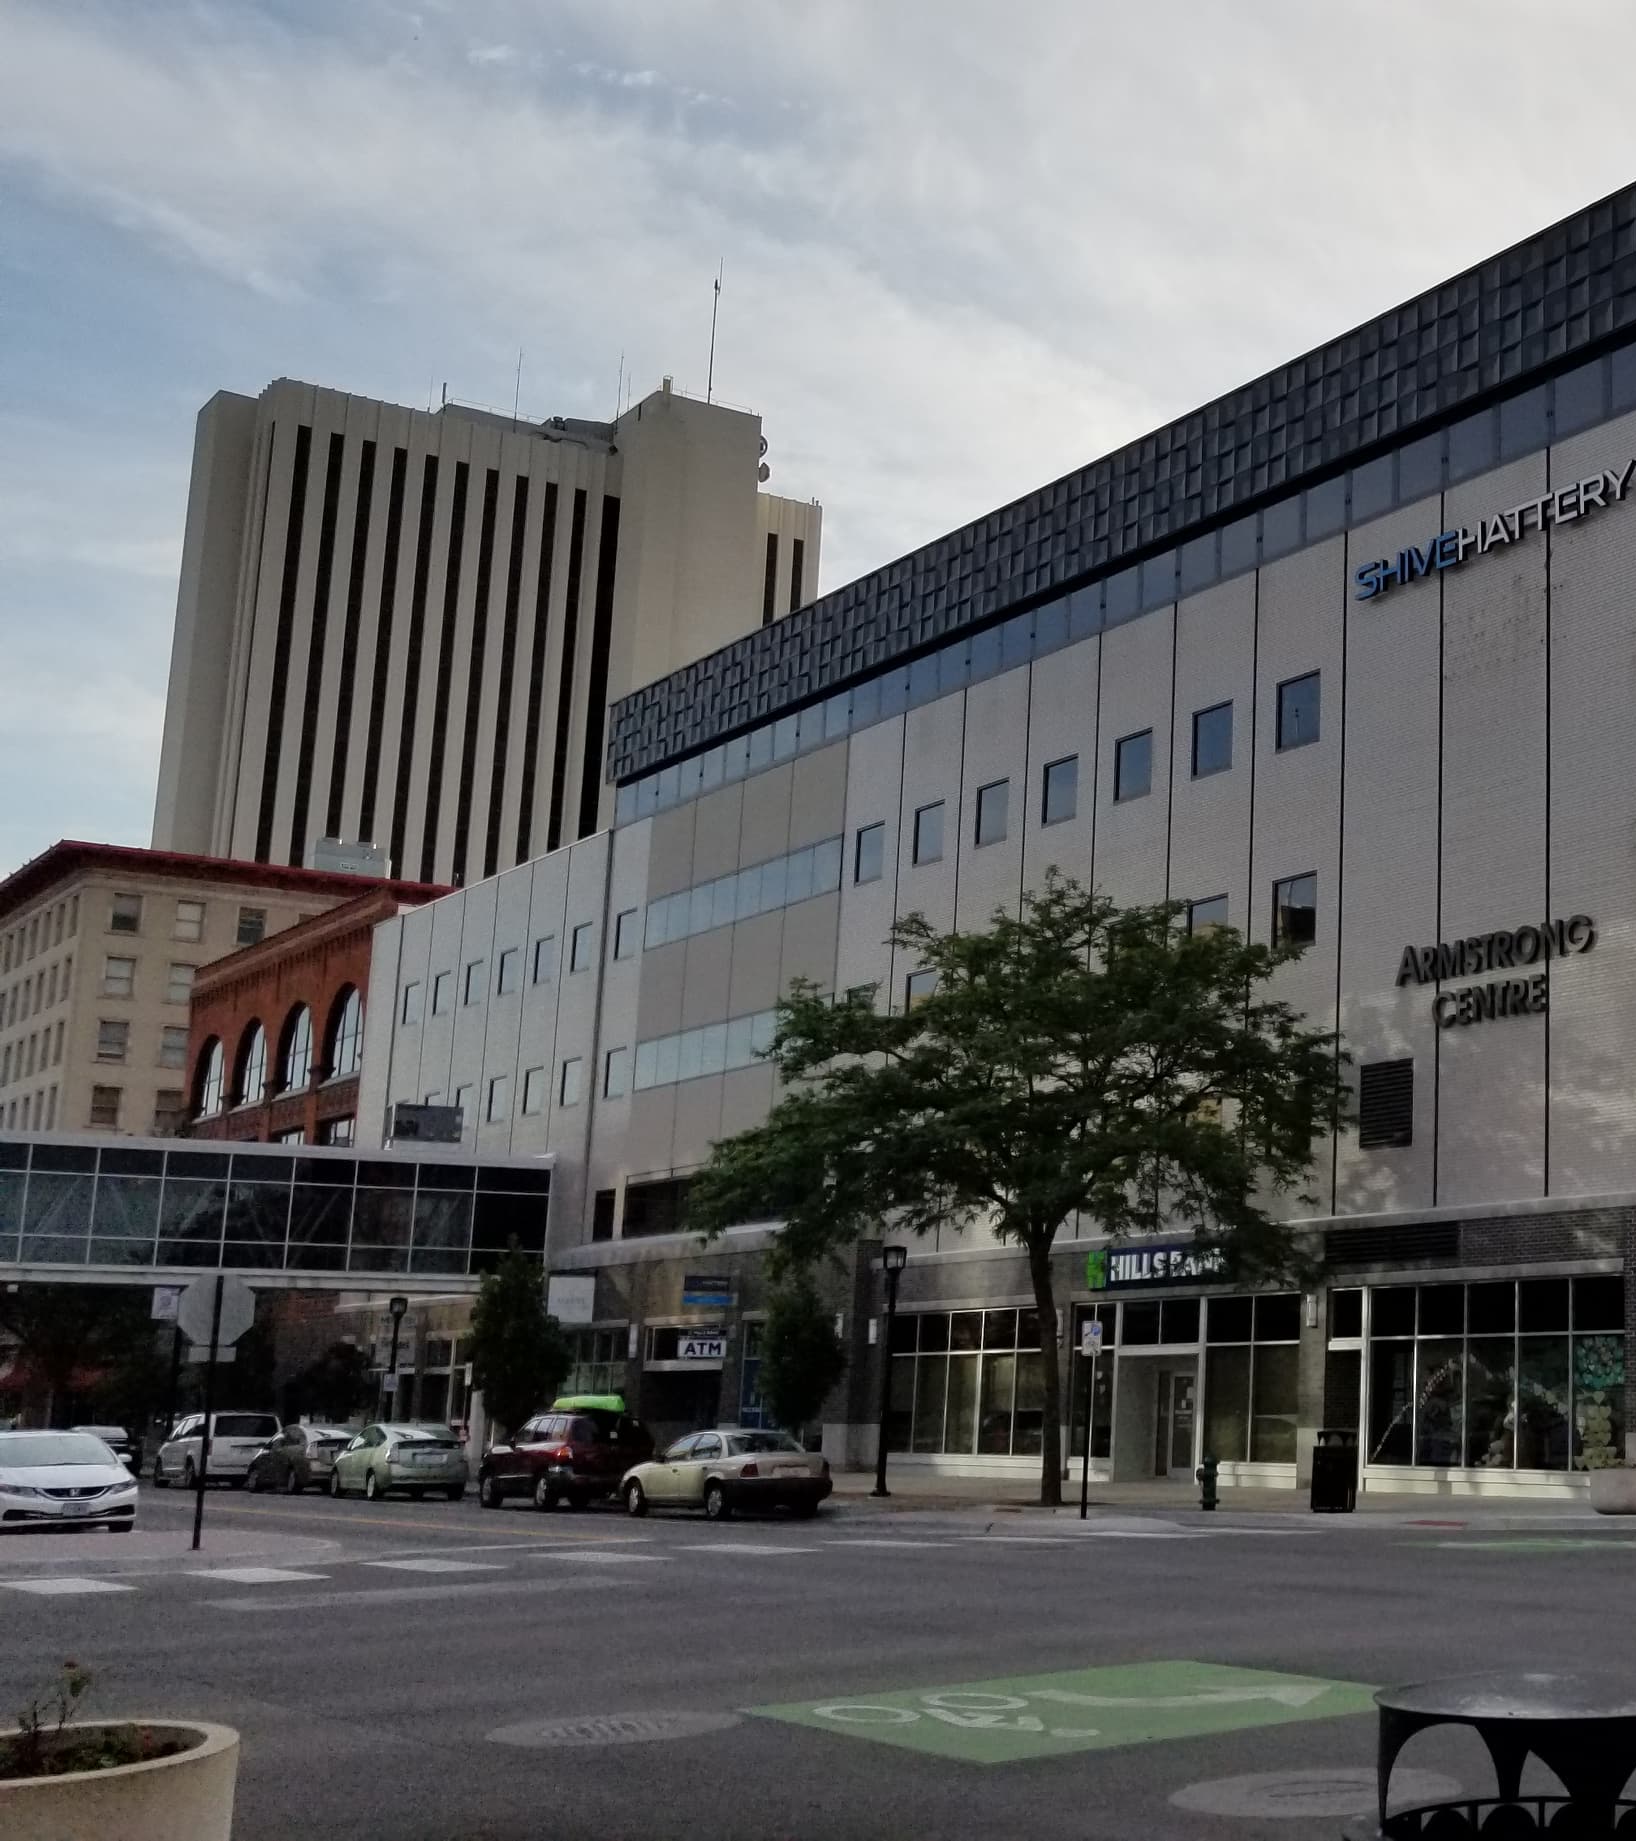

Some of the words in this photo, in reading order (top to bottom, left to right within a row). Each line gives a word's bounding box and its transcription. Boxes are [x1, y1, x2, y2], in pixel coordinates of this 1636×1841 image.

[1395, 914, 1598, 988] ARMSTRONG
[1432, 974, 1550, 1029] CENTRE
[1110, 1252, 1167, 1281] HILLS
[684, 1342, 722, 1356] ATM
